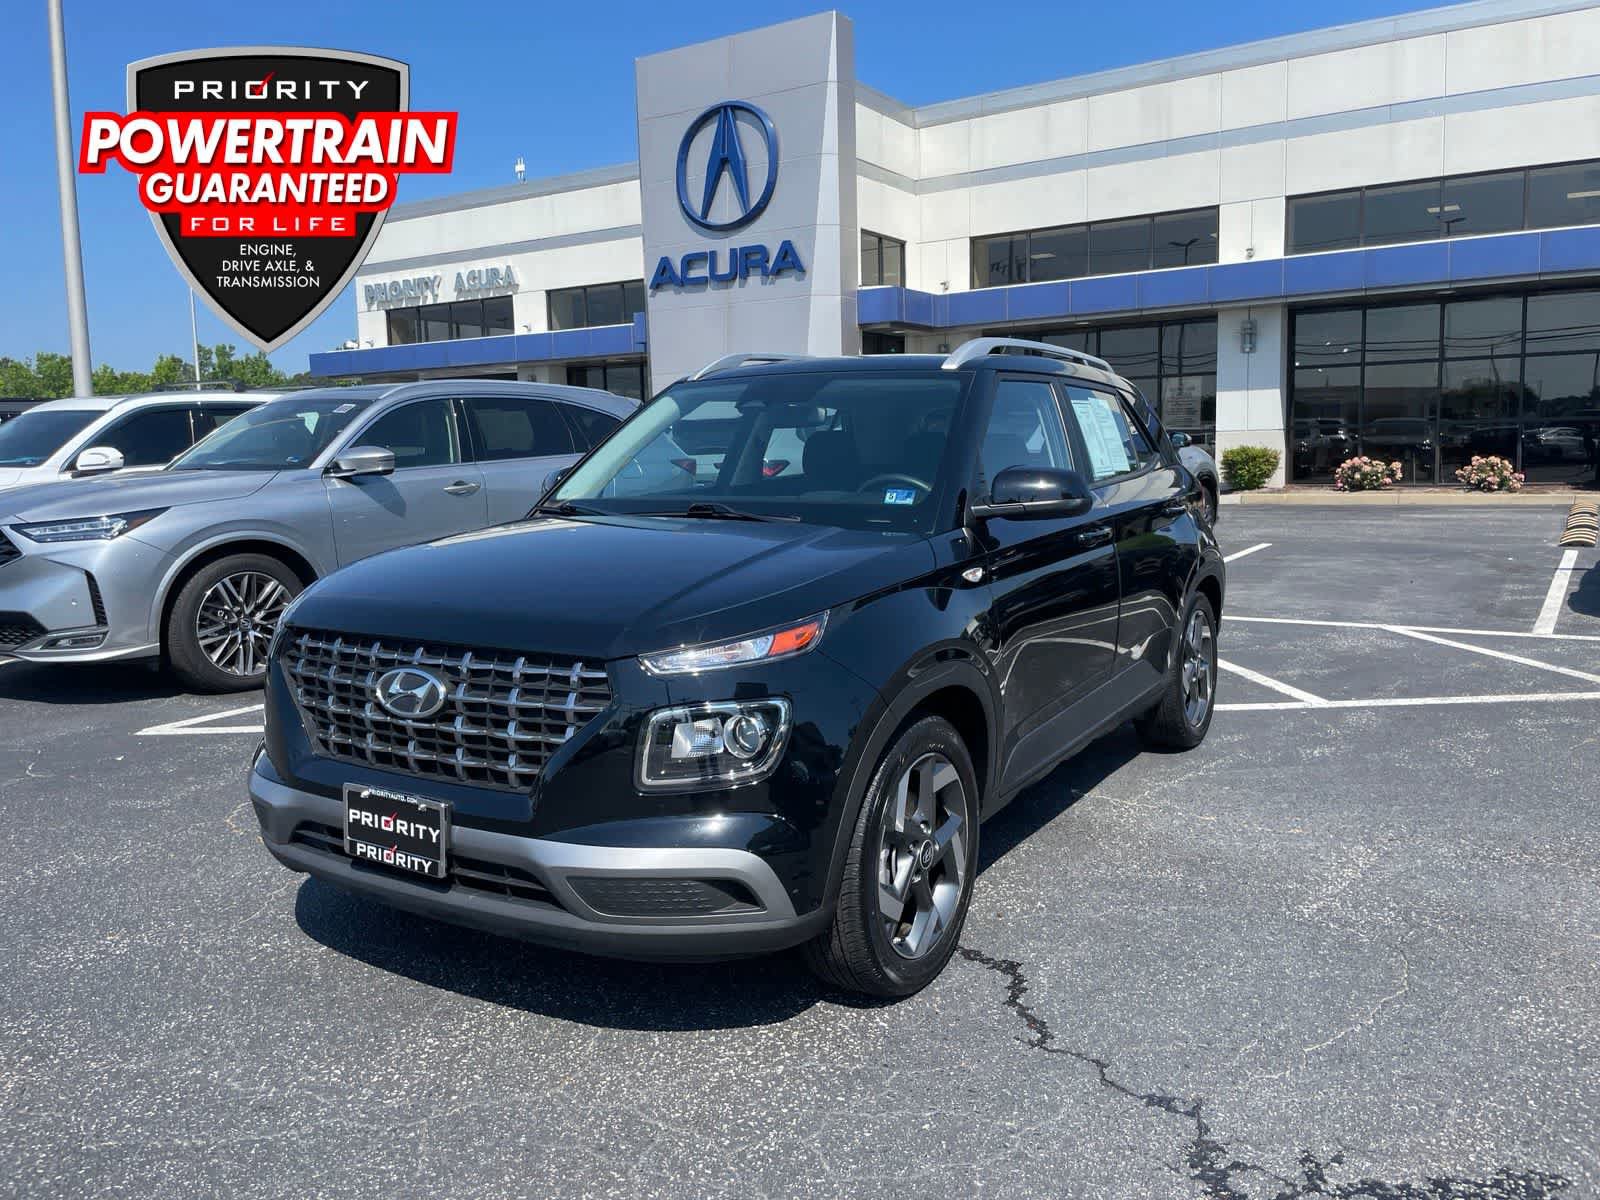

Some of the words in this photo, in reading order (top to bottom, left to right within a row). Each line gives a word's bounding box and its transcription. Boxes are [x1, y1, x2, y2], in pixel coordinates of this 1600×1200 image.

[649, 240, 806, 290] ACURA
[364, 275, 439, 300] PRIORITY
[454, 265, 515, 293] ACURA
[349, 809, 440, 843] PRIORITY
[356, 843, 432, 873] PRIORITY
